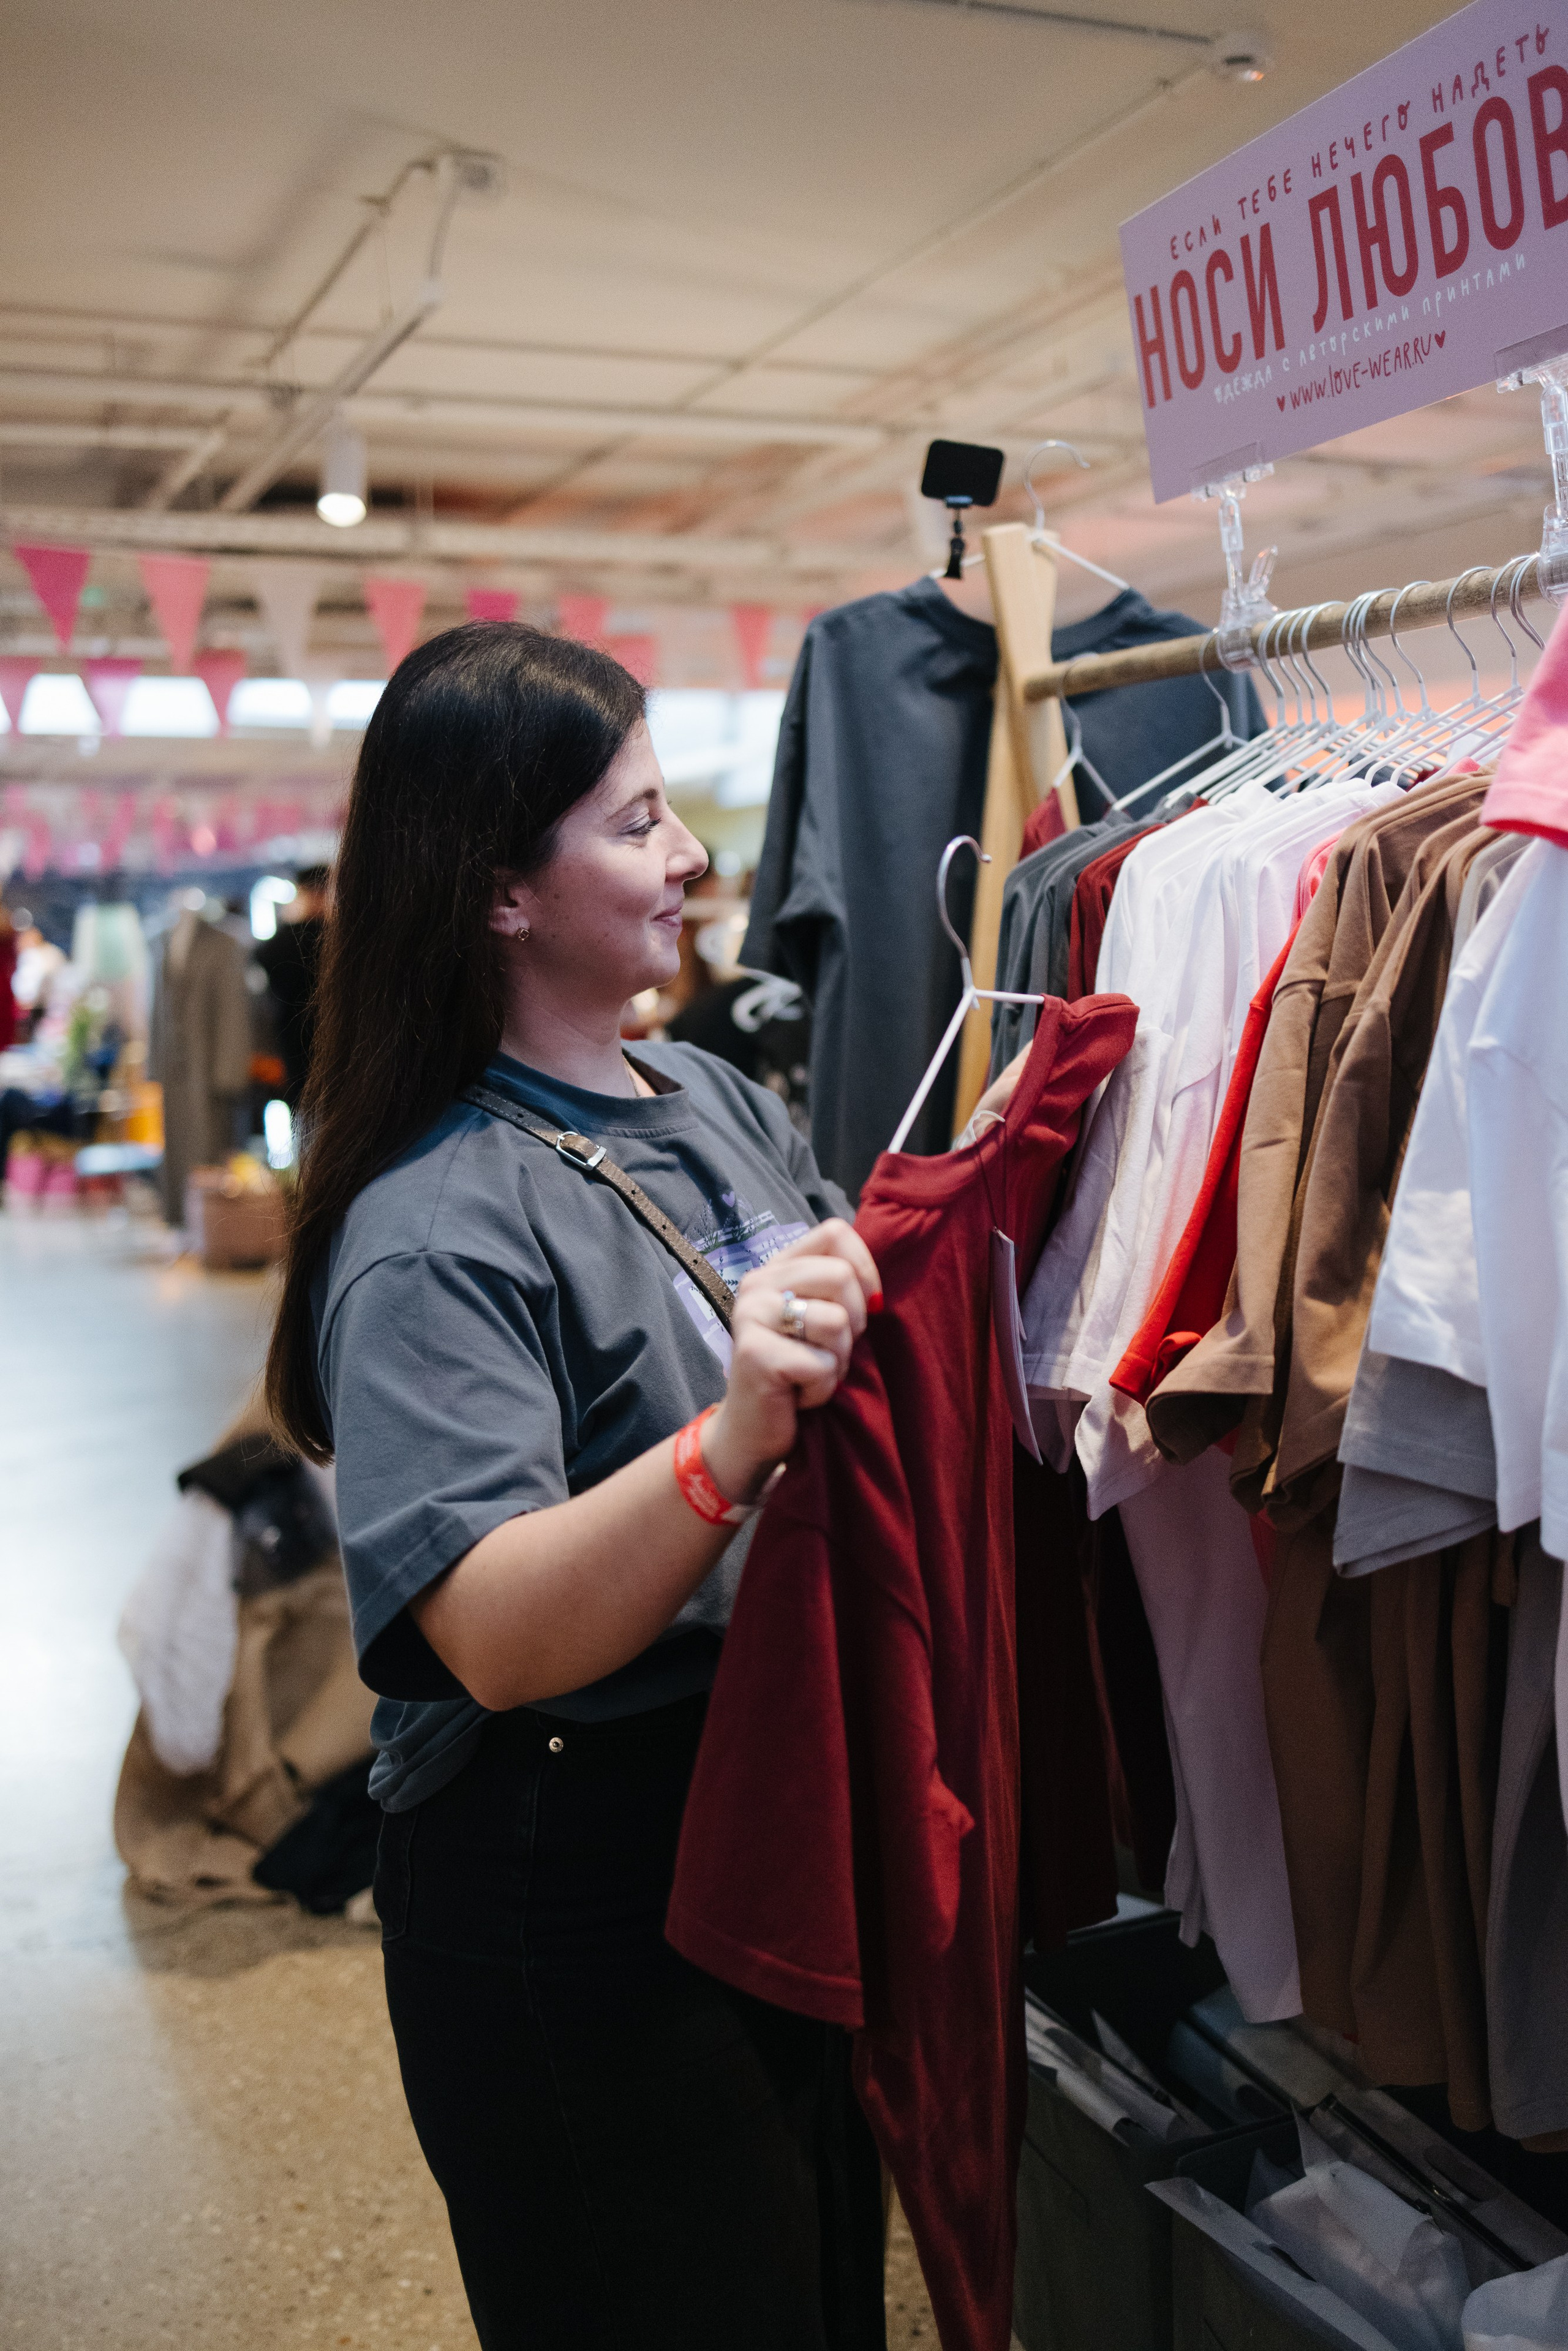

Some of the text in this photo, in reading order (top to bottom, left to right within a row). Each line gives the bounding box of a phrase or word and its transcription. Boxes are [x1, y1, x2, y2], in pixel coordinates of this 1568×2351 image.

[1170, 23, 1550, 260] ЕСЛИ ТЕБЕ НЕЧЕГО НАДЕТЬ
[1134, 222, 1286, 409] НОСИ
[1300, 305, 1409, 367] АВТОРСКИМИ
[1422, 253, 1525, 317] ПРИНТАМИ
